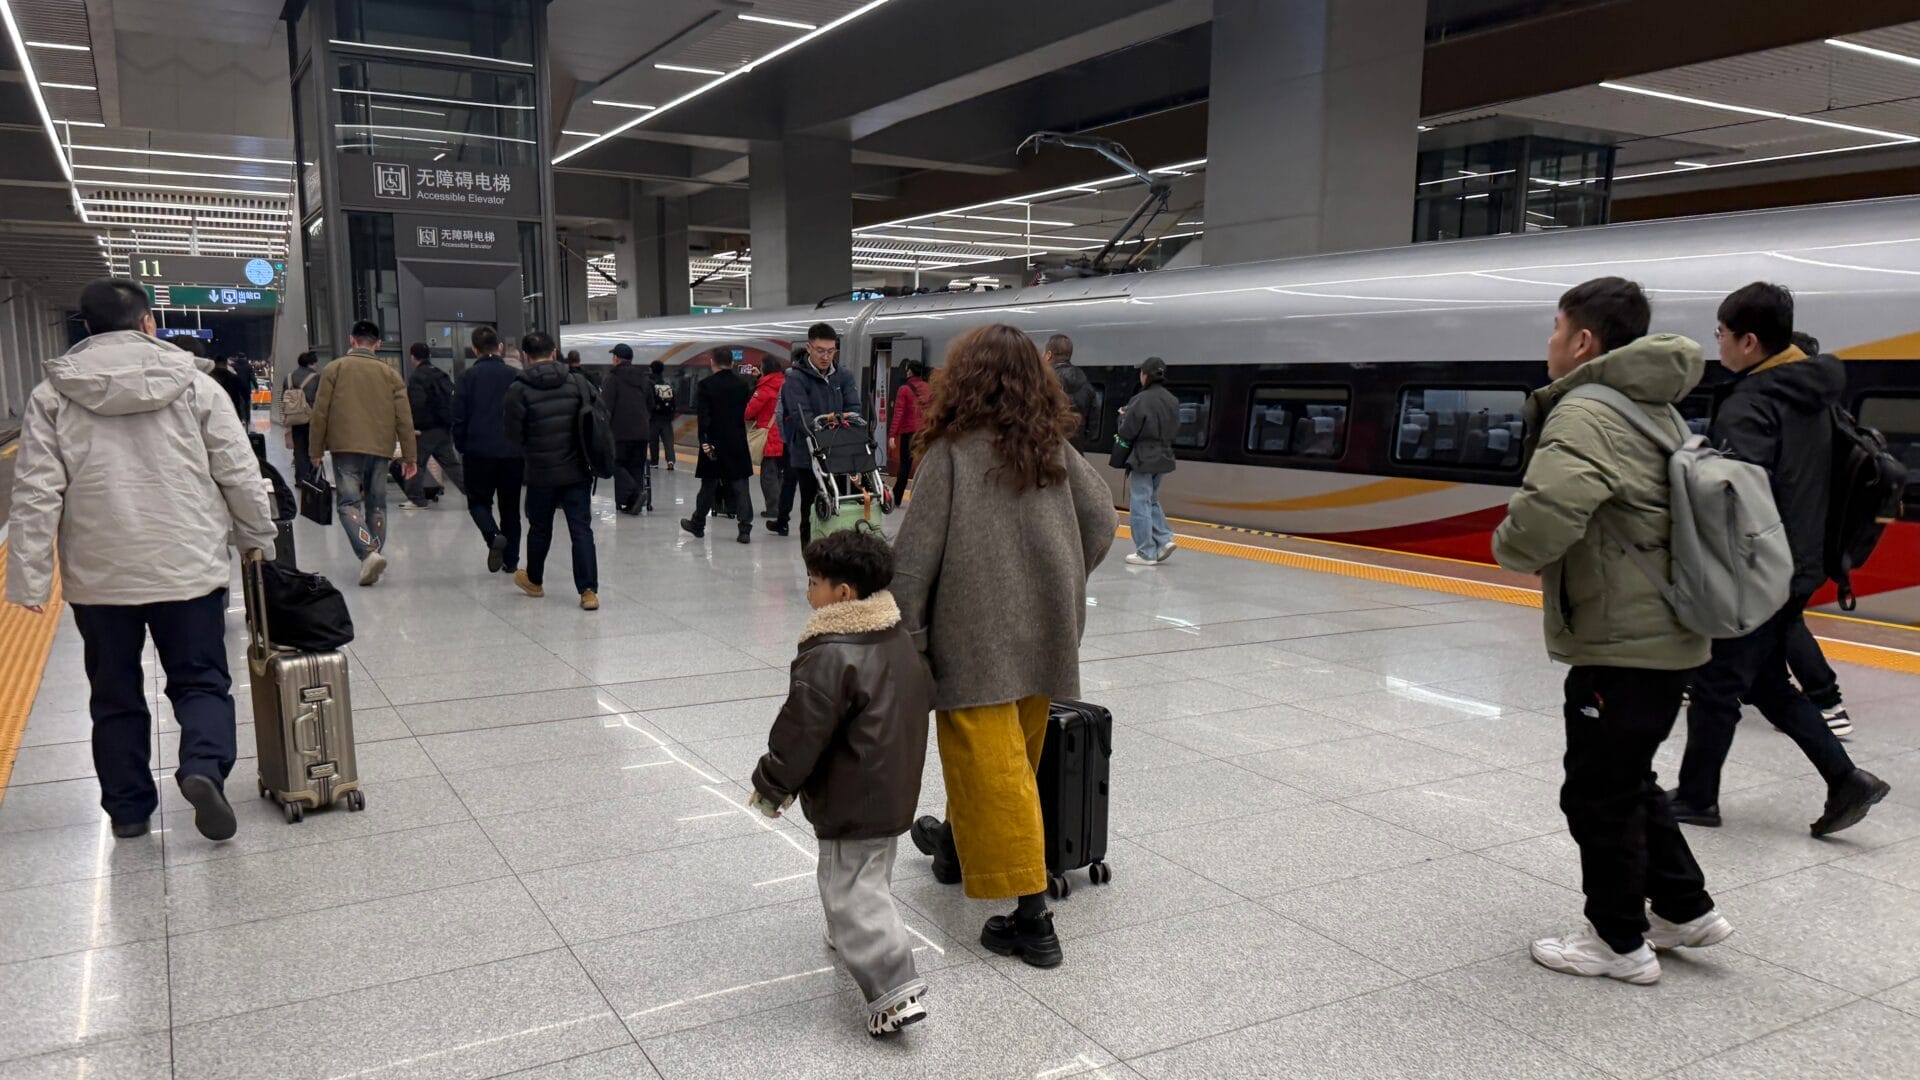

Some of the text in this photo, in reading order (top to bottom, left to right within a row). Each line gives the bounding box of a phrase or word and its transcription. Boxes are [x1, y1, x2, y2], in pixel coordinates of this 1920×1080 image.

[416, 168, 512, 193] 无障碍电梯
[416, 190, 505, 205] Accessible Elevator
[441, 229, 496, 243] 无障碍电梯
[441, 241, 469, 249] Accessible
[139, 258, 163, 277] 11
